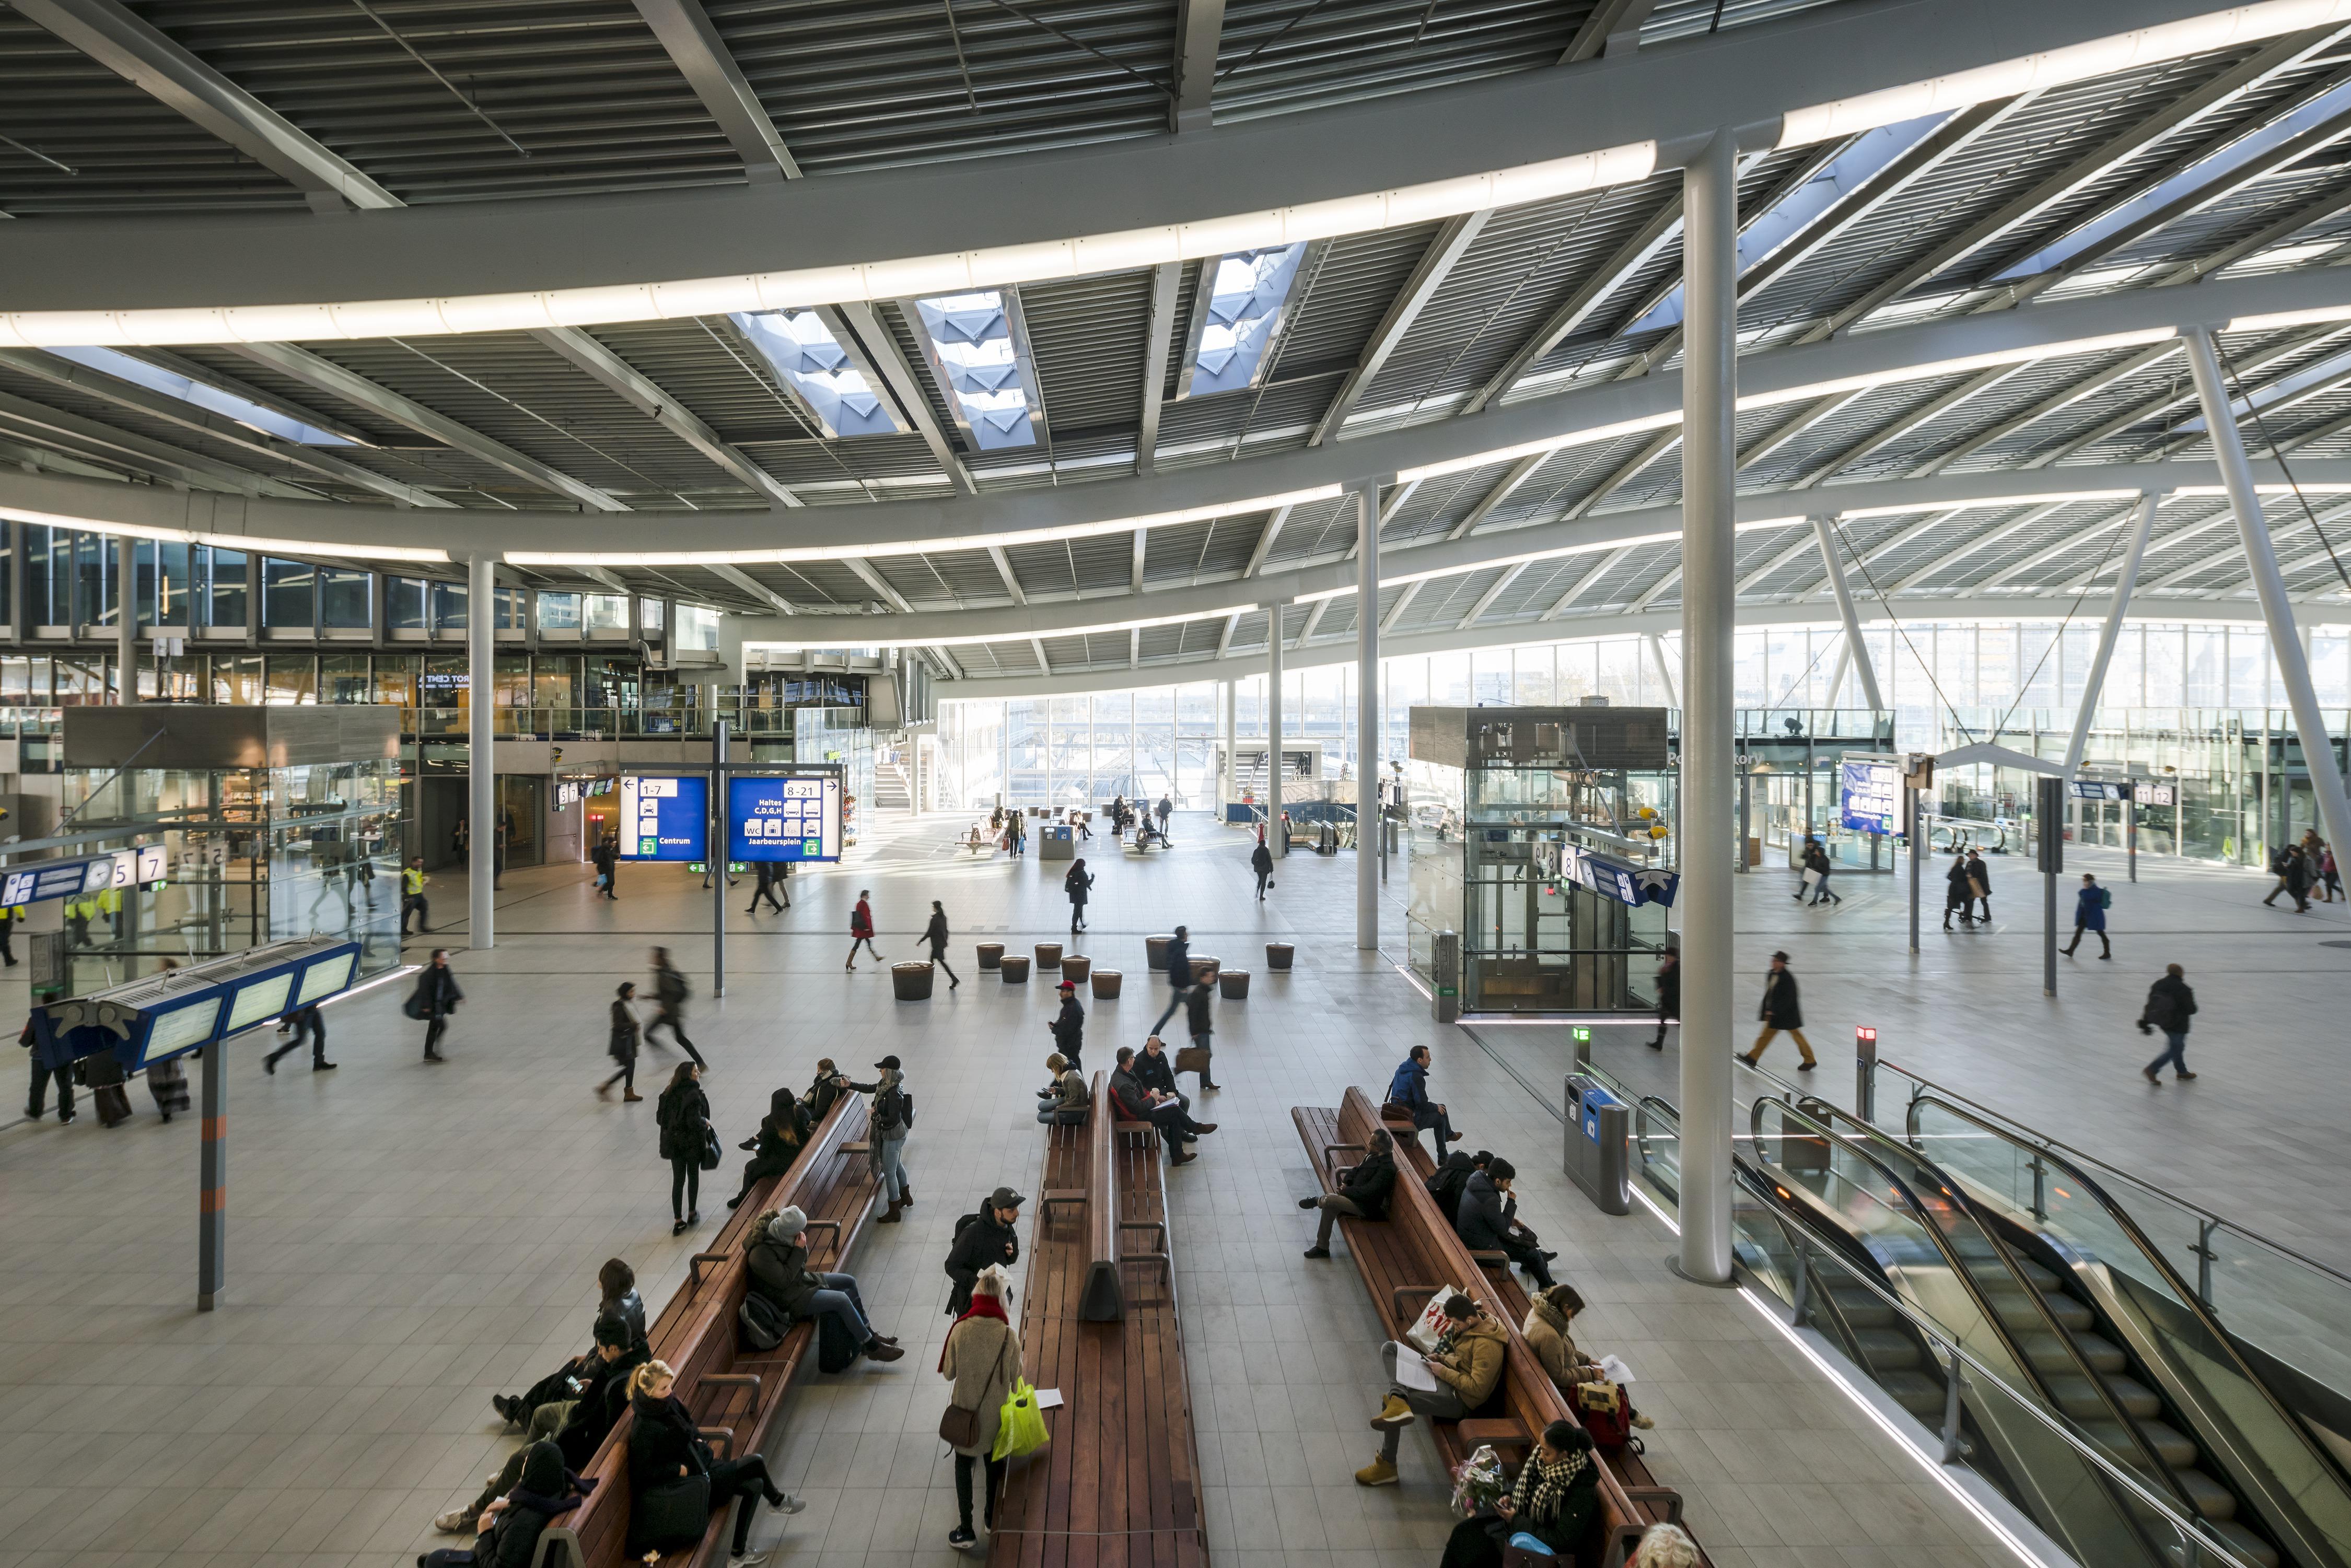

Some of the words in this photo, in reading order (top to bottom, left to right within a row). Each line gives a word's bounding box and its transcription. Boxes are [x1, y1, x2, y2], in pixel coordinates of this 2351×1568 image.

[572, 789, 576, 801] 7
[644, 786, 661, 794] 1-7
[562, 791, 566, 802] 5
[2138, 791, 2149, 801] 11
[2156, 792, 2169, 803] 12
[749, 838, 801, 847] Jaarbeursplein
[149, 859, 159, 877] 7
[1566, 857, 1572, 876] 8
[116, 864, 126, 883] 5
